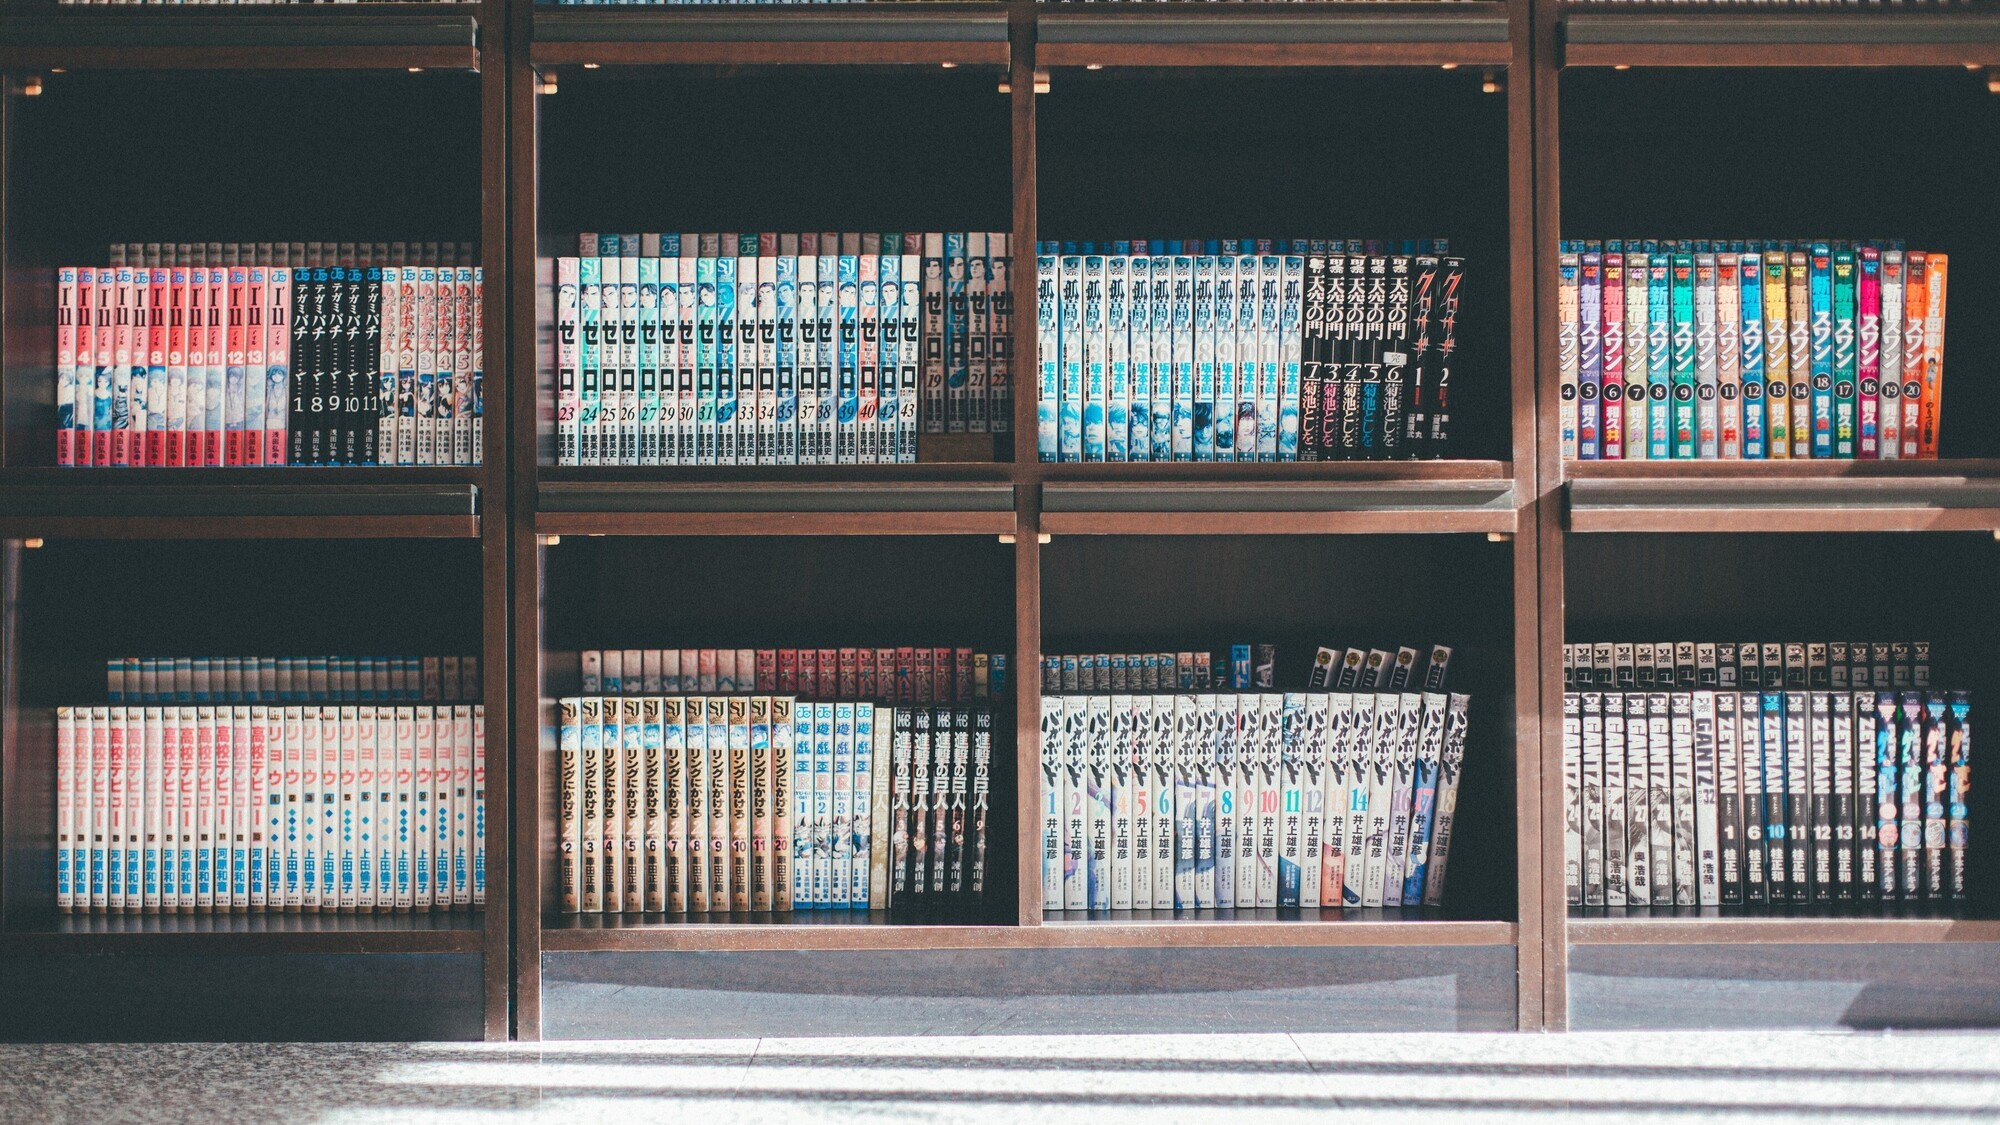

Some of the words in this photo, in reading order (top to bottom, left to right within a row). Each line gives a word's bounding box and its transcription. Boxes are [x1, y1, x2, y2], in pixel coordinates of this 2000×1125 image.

[294, 284, 308, 341] テガミバチ
[312, 285, 326, 341] テガミバチ
[329, 283, 343, 339] テガミバチ
[347, 285, 360, 341] テガミバチ
[365, 283, 379, 339] テガミバチ
[1305, 275, 1325, 339] 天空の門
[1325, 277, 1344, 341] 天空の門
[1345, 277, 1365, 341] 天空の門
[1366, 277, 1385, 341] 天空の門
[1387, 277, 1407, 340] 天空の門
[1580, 285, 1600, 371] 新宿スワン
[1604, 286, 1623, 371] 新宿スワン
[1650, 286, 1669, 371] 新宿スワン
[1697, 286, 1716, 371] 新宿スワン
[1741, 285, 1762, 370] 新宿スワン
[59, 351, 71, 363] 3
[78, 351, 90, 363] 4
[98, 351, 110, 364] 5
[116, 350, 128, 363] 6
[151, 351, 162, 364] 8
[189, 352, 202, 364] 10
[208, 351, 219, 364] 11
[228, 351, 243, 364] 12
[247, 350, 262, 363] 13
[270, 351, 285, 363] 14
[383, 356, 390, 369] 1
[401, 355, 413, 368] 2
[420, 355, 431, 368] 3
[438, 355, 449, 369] 4
[457, 355, 469, 368] 5
[928, 374, 941, 387] 19
[970, 373, 984, 386] 21
[1415, 368, 1421, 386] 1
[1440, 368, 1449, 387] 2
[294, 397, 303, 412] 1
[311, 398, 323, 412] 8
[329, 396, 340, 410] 9
[345, 398, 359, 412] 10
[363, 396, 377, 411] 11
[901, 404, 914, 417] 43
[560, 407, 574, 420] 23
[602, 408, 616, 421] 25
[641, 408, 657, 420] 27
[680, 407, 693, 420] 30
[739, 406, 754, 419] 33
[800, 406, 814, 419] 37
[860, 405, 874, 418] 40
[881, 406, 894, 419] 42
[269, 727, 282, 785] リョウ
[359, 725, 374, 784] リョウ
[417, 724, 431, 783] リョウ
[436, 724, 450, 782] リョウ
[1696, 719, 1714, 787] GANTZ
[1719, 717, 1736, 794] ZETMAN
[1743, 717, 1761, 794] ZETMAN
[1764, 717, 1783, 793] ZETMAN
[1813, 718, 1830, 794] ZETMAN
[1860, 718, 1876, 794] ZETMAN
[111, 728, 123, 827] 高校デビュー
[180, 728, 193, 827] 高校デビュー
[216, 726, 229, 825] 高校デビュー
[252, 726, 264, 825] 高校デビュー
[894, 732, 911, 811] 進撃の巨人
[913, 732, 930, 811] 進撃の巨人
[934, 732, 951, 811] 進撃の巨人
[952, 731, 968, 811] 進撃の巨人
[973, 732, 990, 811] 進撃の巨人
[563, 751, 575, 820] リングにかけろ
[585, 750, 596, 819] リングにかけろ
[647, 749, 658, 818] リングにかけろ
[734, 750, 745, 819] リングにかけろ
[1048, 792, 1055, 814] 1
[1072, 792, 1080, 814] 2
[1138, 790, 1146, 814] 5
[1159, 790, 1169, 814] 6
[1243, 790, 1253, 814] 9
[1260, 790, 1278, 813] 10
[1285, 790, 1299, 812] 11
[1306, 790, 1322, 813] 12
[1351, 788, 1367, 810] 14
[1703, 789, 1714, 804] 32
[800, 804, 805, 813] 1
[818, 803, 826, 813] 2
[857, 803, 865, 812] 4
[897, 820, 905, 830] 3
[936, 821, 943, 830] 5
[977, 820, 983, 830] 9
[1724, 826, 1734, 839] 1
[1748, 826, 1761, 839] 6
[1767, 825, 1784, 838] 10
[1789, 826, 1805, 839] 11
[1813, 826, 1831, 839] 12
[1860, 826, 1876, 839] 14
[565, 843, 572, 853] 2
[587, 842, 593, 852] 3
[629, 841, 635, 851] 5
[650, 841, 656, 850] 6
[734, 841, 746, 852] 10
[775, 839, 787, 850] 20
